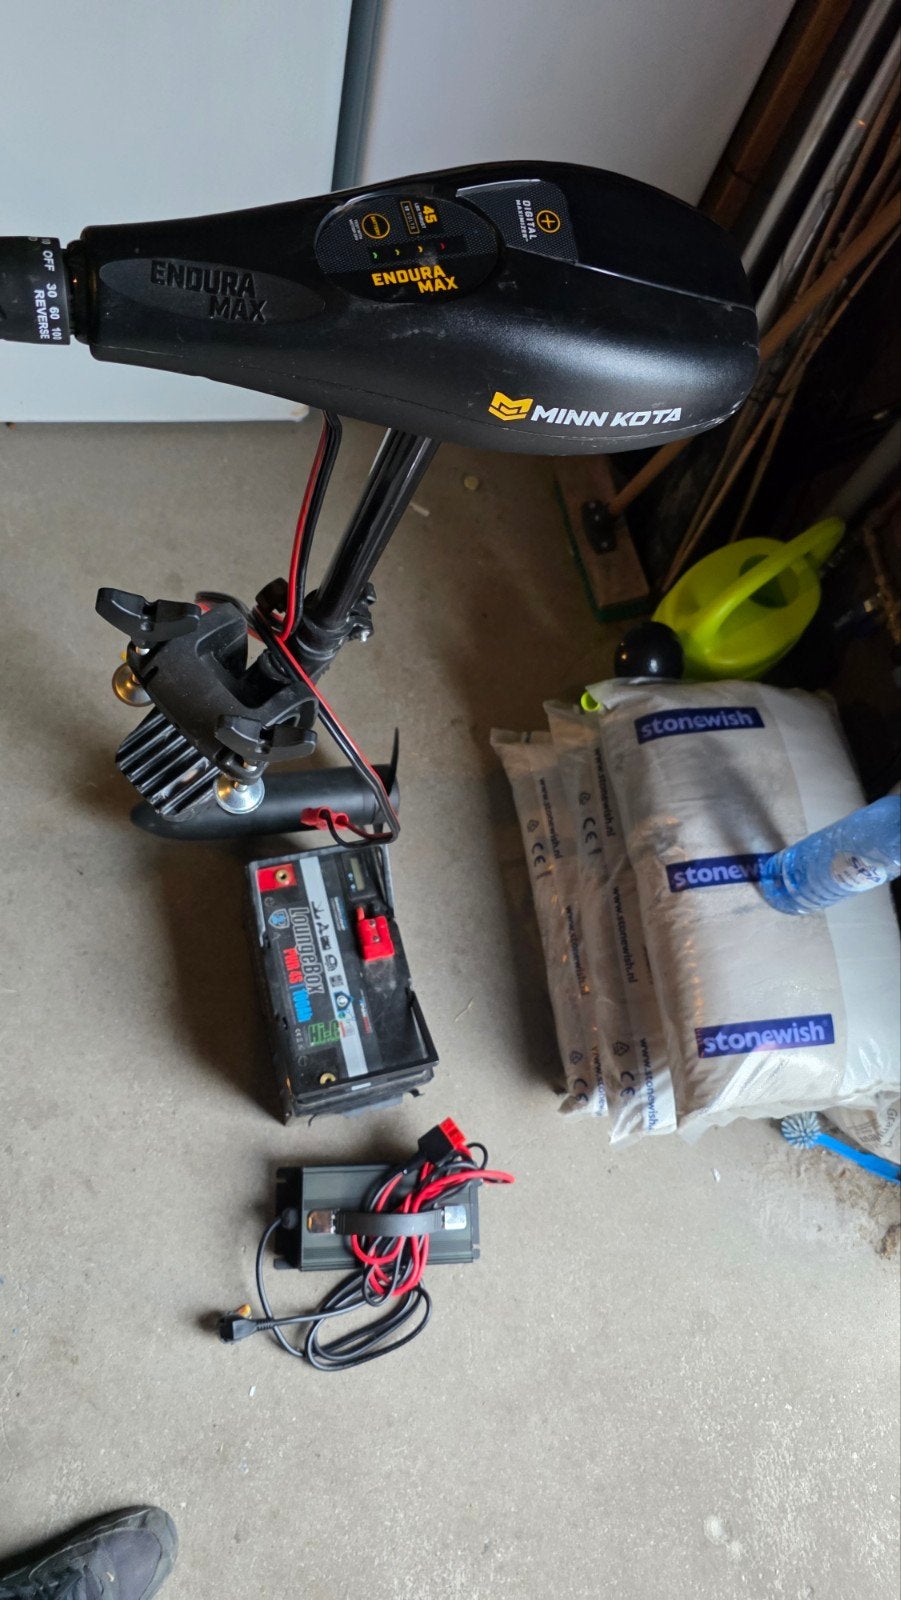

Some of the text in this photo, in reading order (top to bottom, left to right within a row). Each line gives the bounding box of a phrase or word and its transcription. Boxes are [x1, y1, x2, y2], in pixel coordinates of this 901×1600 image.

[422, 204, 438, 224] 45
[522, 200, 538, 240] DIGITAL
[42, 250, 55, 272] OFF
[150, 260, 256, 299] ENDURA
[371, 265, 447, 287] ENDURA
[417, 276, 459, 294] MAX
[46, 283, 58, 298] 30
[33, 289, 50, 340] REVERSE
[49, 306, 60, 320] 60
[209, 295, 268, 324] MAX
[51, 327, 63, 340] 100
[530, 404, 682, 427] MINN KOTA
[641, 710, 754, 738] stonewish
[288, 906, 326, 994] LoungeBox
[702, 1020, 825, 1053] stonewish
